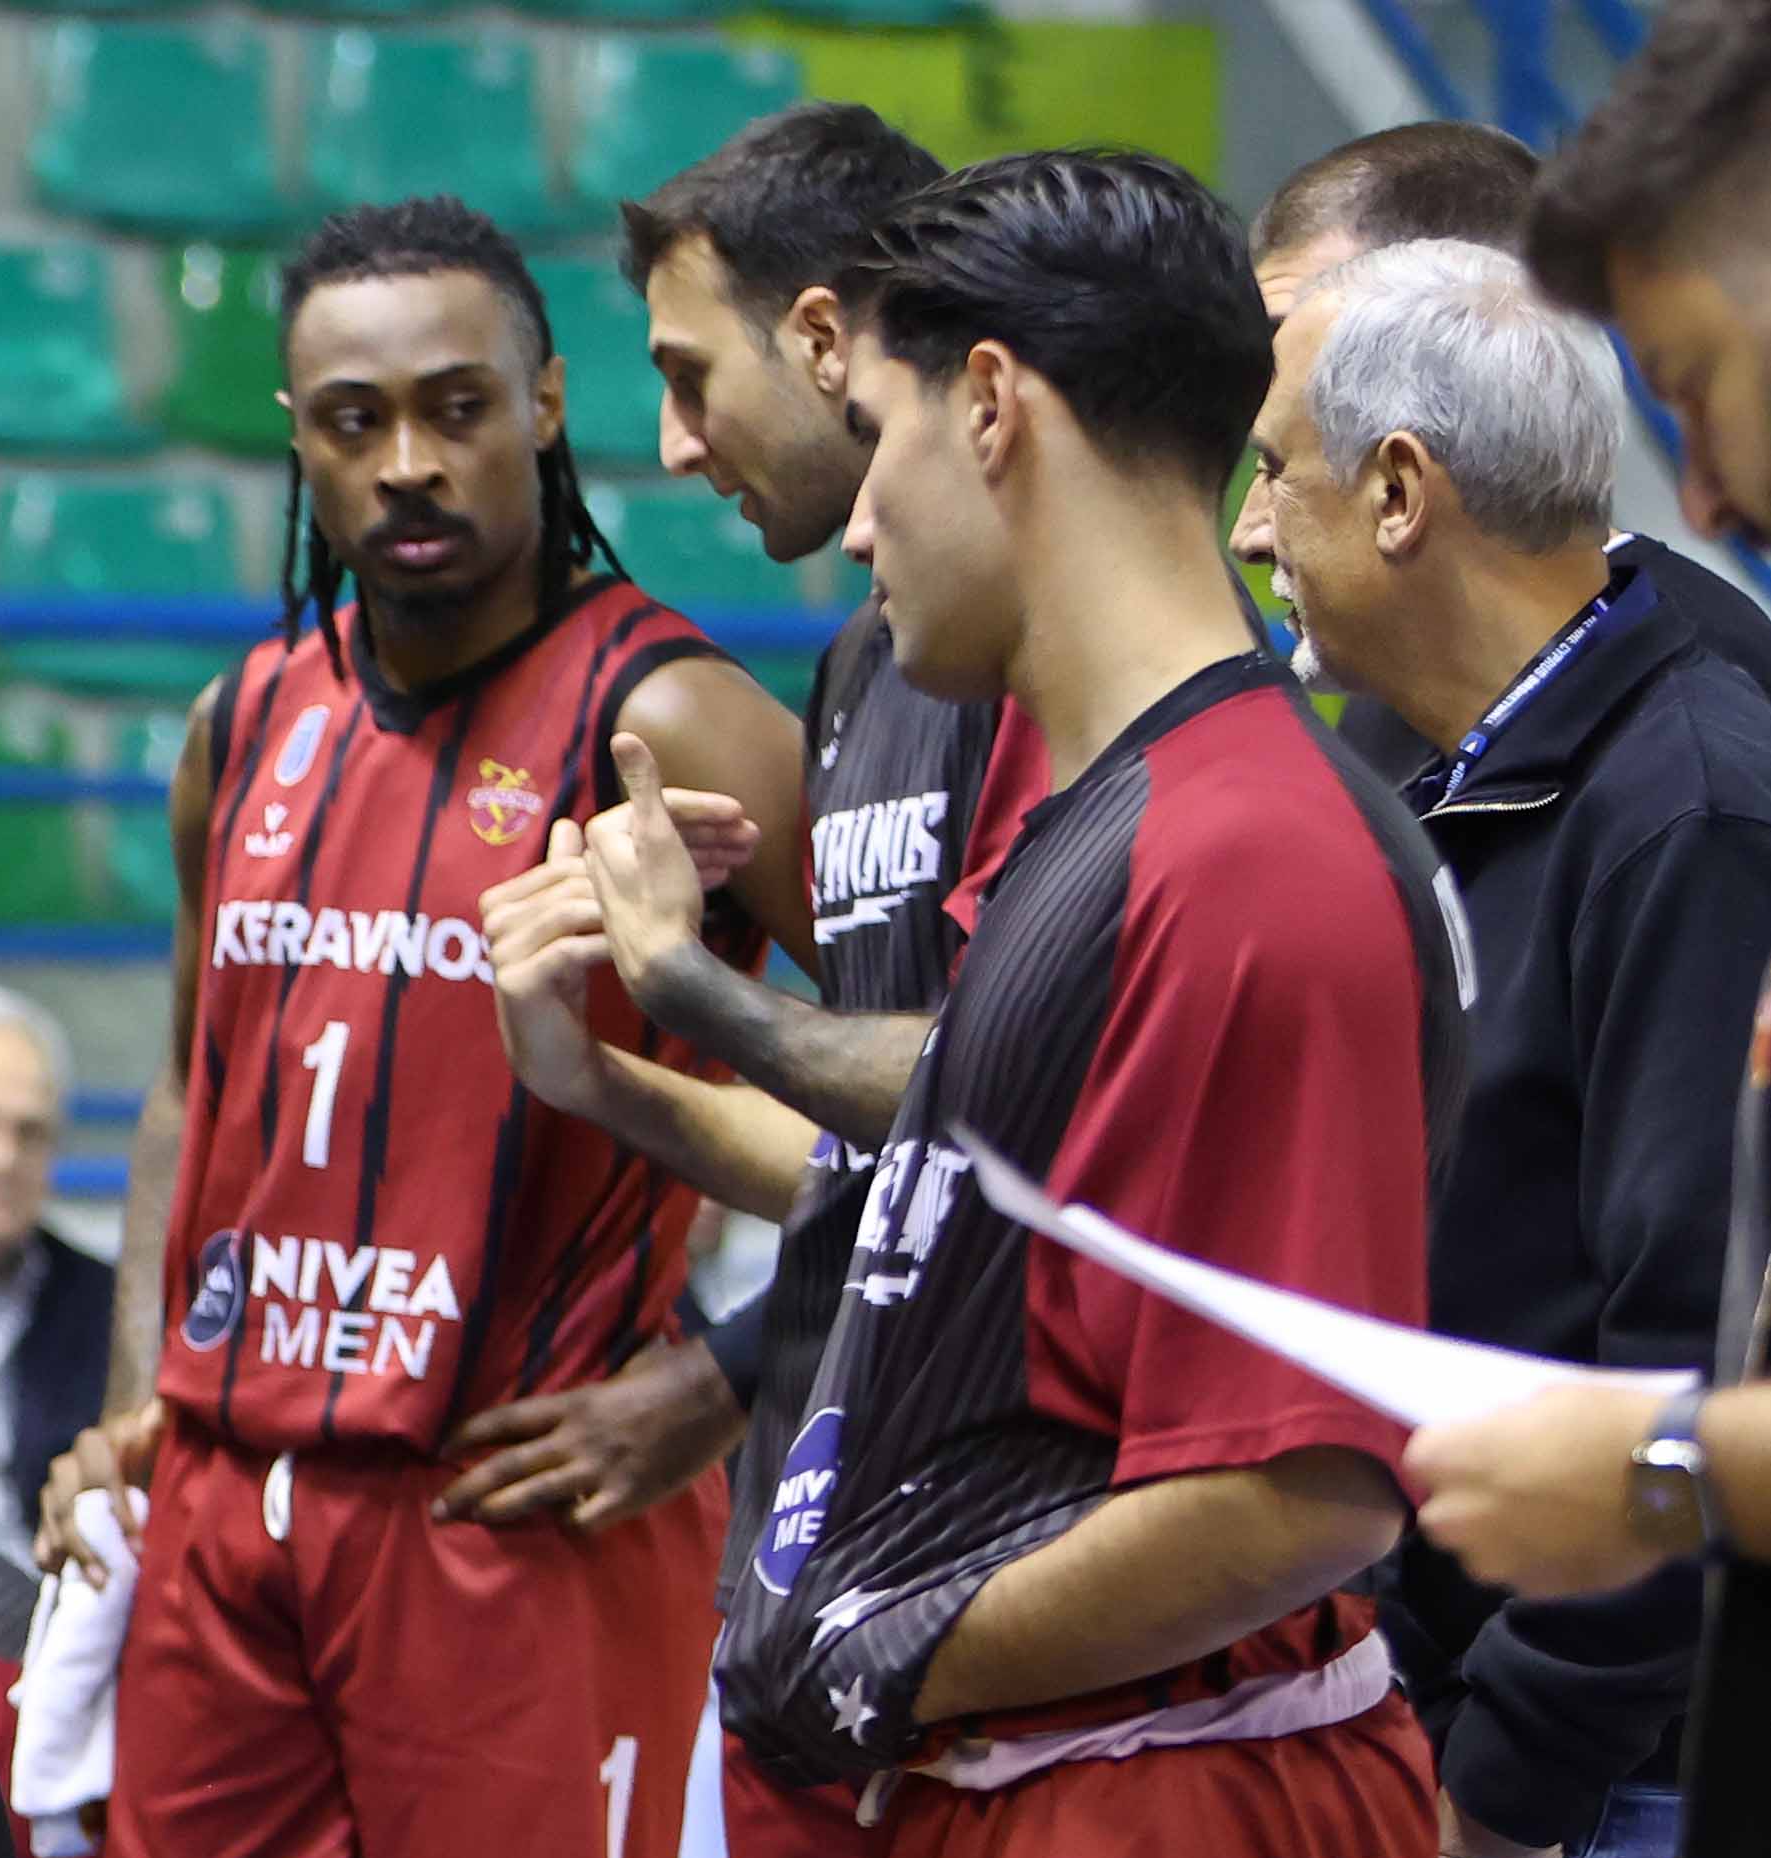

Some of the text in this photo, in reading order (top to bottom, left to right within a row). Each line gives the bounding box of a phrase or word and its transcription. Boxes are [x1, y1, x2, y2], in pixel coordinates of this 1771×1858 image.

[1534, 641, 1571, 678] CYPRUS
[302, 1020, 350, 1169] 1
[250, 1232, 462, 1321] NIVEA
[260, 1302, 437, 1380] MEN
[772, 1468, 837, 1514] NIV
[772, 1510, 826, 1552] ME
